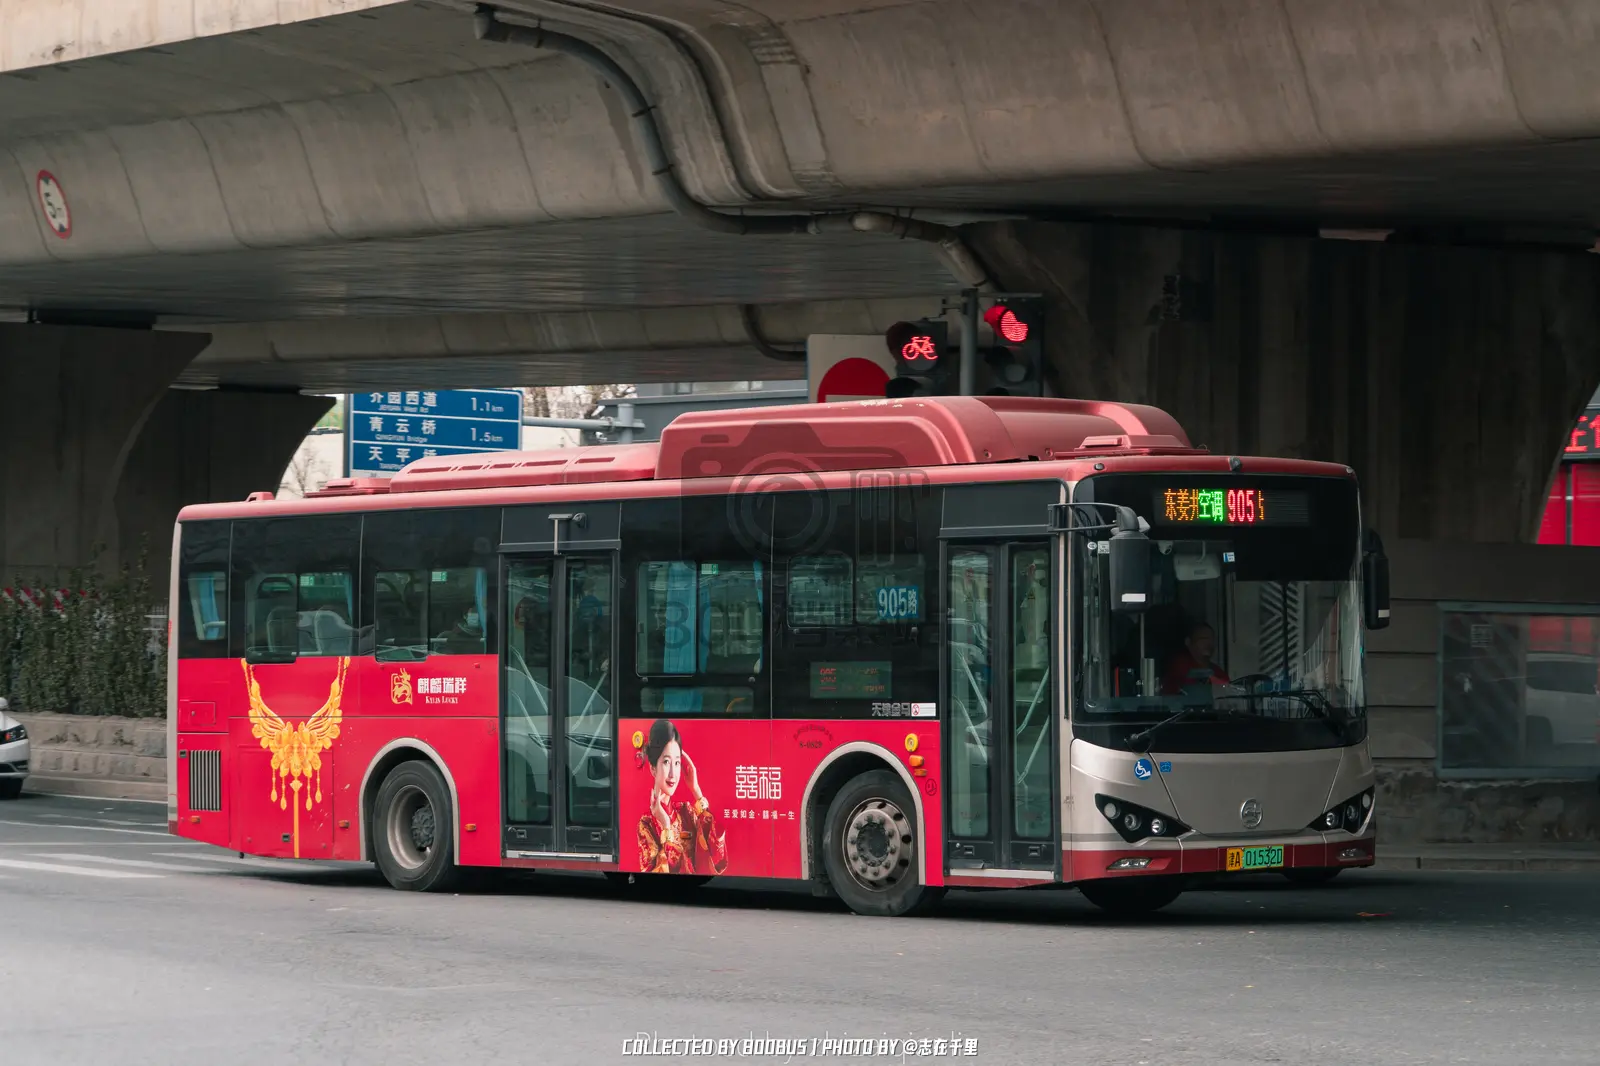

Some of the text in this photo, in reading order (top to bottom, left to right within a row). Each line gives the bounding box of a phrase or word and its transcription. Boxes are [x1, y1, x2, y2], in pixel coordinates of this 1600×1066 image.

[369, 416, 436, 435] 青云桥
[1199, 489, 1224, 521] 空调
[1227, 489, 1254, 522] 905
[878, 587, 917, 617] 905路
[417, 677, 467, 694] 麒麟瑞祥
